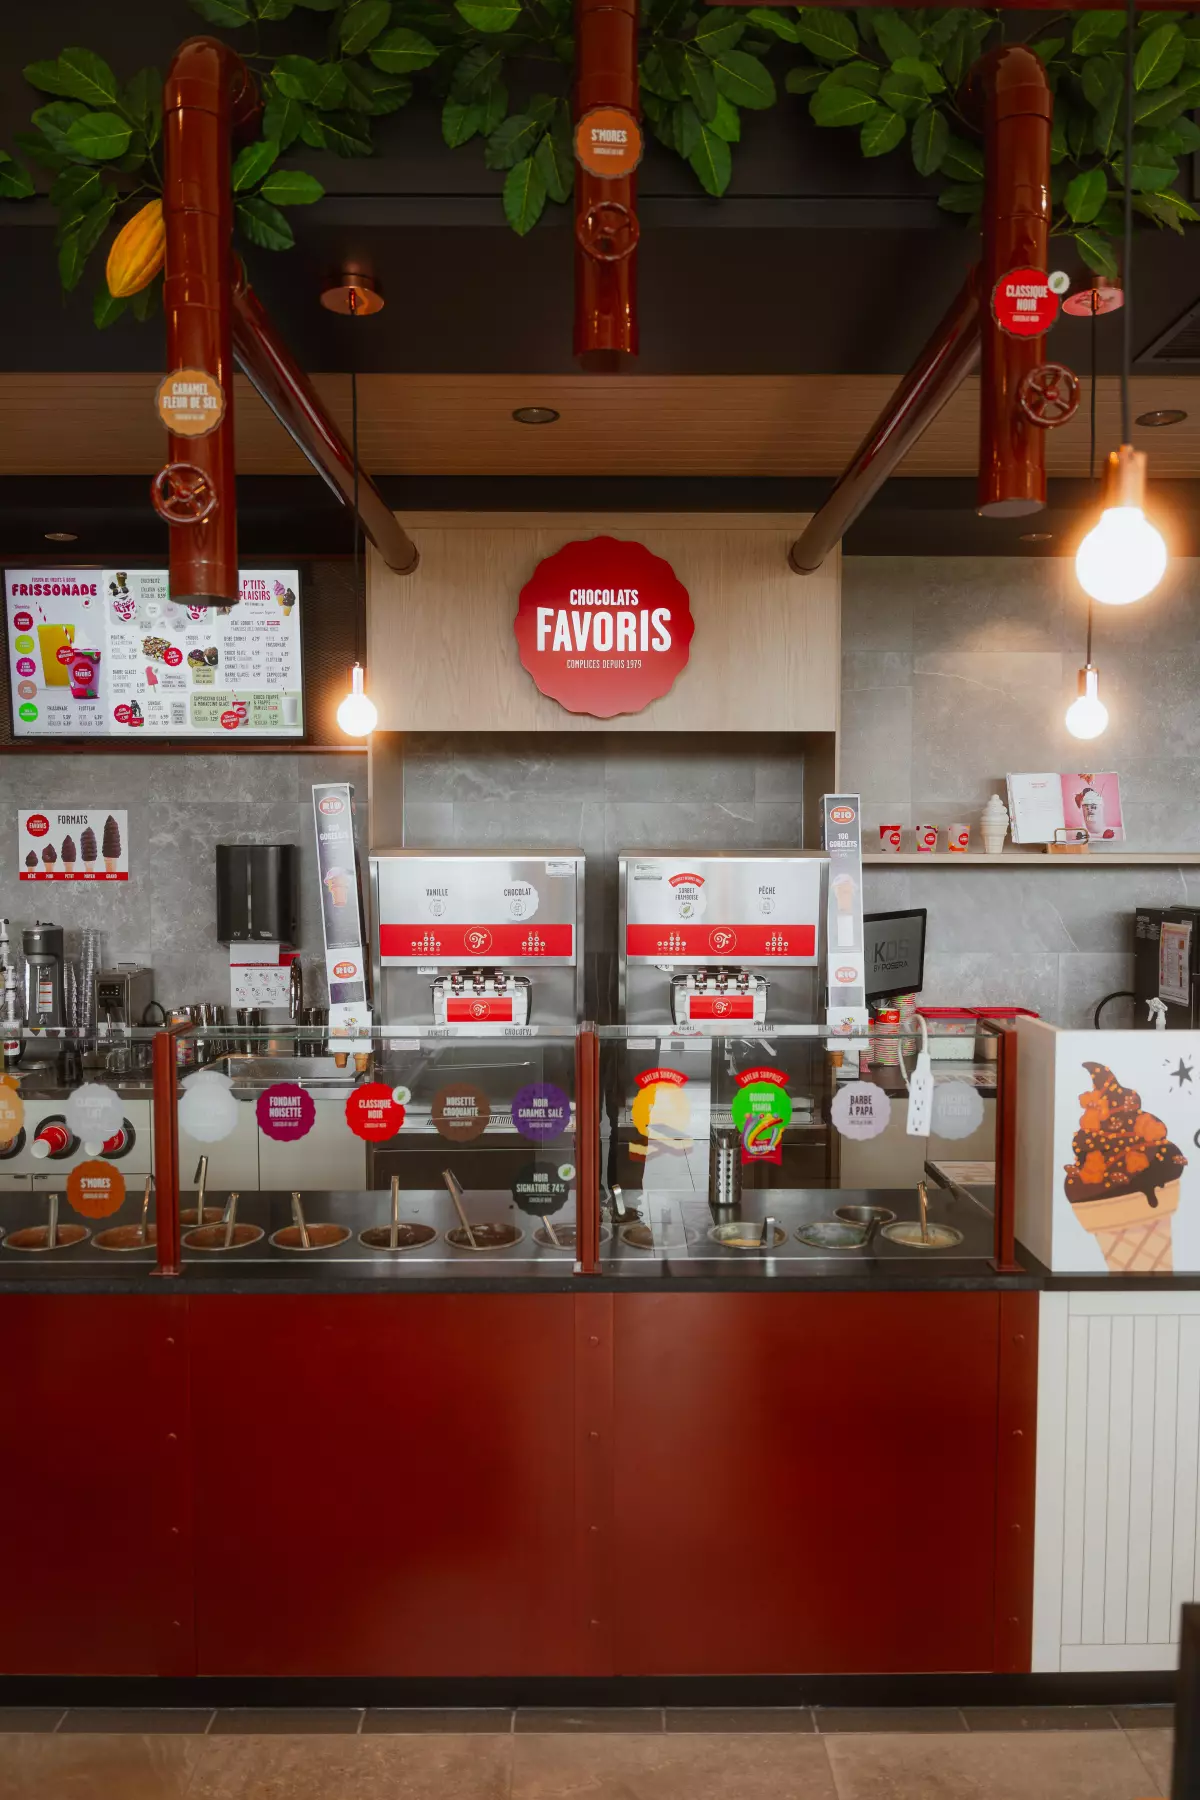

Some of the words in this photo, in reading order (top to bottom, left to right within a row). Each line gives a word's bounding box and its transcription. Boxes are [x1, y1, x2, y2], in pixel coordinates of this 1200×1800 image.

[591, 128, 627, 143] S'MORES
[1006, 284, 1048, 298] CLASSIQUE
[1016, 298, 1037, 311] NOIR
[172, 383, 208, 395] CARAMEL
[163, 396, 188, 409] FLEUR
[190, 397, 200, 409] DE
[203, 397, 217, 409] SEL
[12, 584, 98, 596] FRISSONADE
[243, 580, 266, 590] P'TITS
[569, 589, 639, 606] CHOCOLATS
[536, 607, 672, 652] FAVORIS
[566, 659, 601, 669] COMPLICES
[602, 659, 625, 669] DEPUIS
[626, 659, 642, 669] 1979
[58, 815, 88, 824] FORMATS
[426, 888, 448, 896] VANILLE
[504, 888, 531, 896] CHOCOLAT
[758, 886, 776, 895] PÊCHE
[336, 966, 354, 974] RIO
[881, 960, 908, 972] POSERA
[837, 970, 856, 978] RIO
[641, 1071, 660, 1084] SAVEUR
[660, 1071, 684, 1084] SURPRISE
[741, 1071, 759, 1084] SAVEUR
[759, 1070, 784, 1084] SURPRISE
[269, 1096, 302, 1106] FONDANT
[359, 1100, 392, 1109] CLASSIQUE
[446, 1096, 476, 1106] NOISETTE
[533, 1098, 548, 1107] NOIR
[850, 1095, 872, 1105] BARBE
[269, 1107, 302, 1118] NOISETTE
[368, 1110, 383, 1119] NOIR
[443, 1106, 479, 1117] CROQUANTE
[518, 1108, 546, 1118] CARAMEL
[547, 1106, 563, 1118] SALÉ
[856, 1106, 874, 1116] PAPA
[533, 1173, 548, 1182] NOIR
[80, 1178, 111, 1188] S'MORES
[516, 1184, 550, 1193] SIGNATURE
[551, 1184, 565, 1193] 74%
